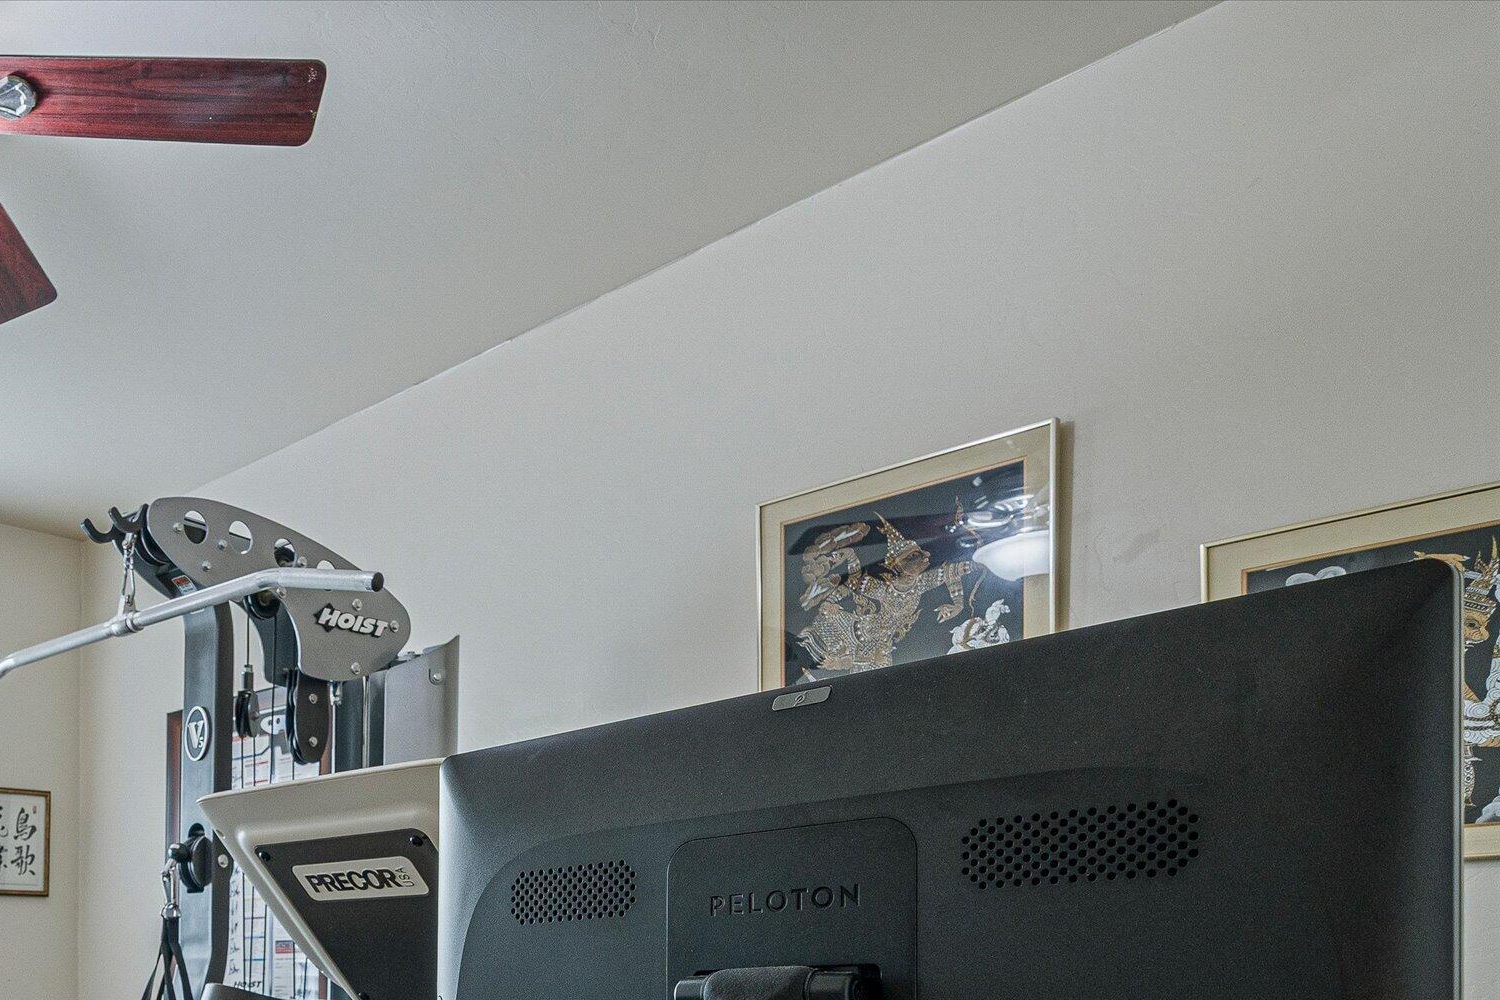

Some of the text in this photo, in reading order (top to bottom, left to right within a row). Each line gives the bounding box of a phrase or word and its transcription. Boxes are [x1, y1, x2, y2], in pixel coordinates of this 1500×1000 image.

[318, 606, 389, 637] HOIST
[304, 868, 403, 893] PRECOR
[395, 867, 415, 888] USA
[710, 883, 861, 917] PELOTON
